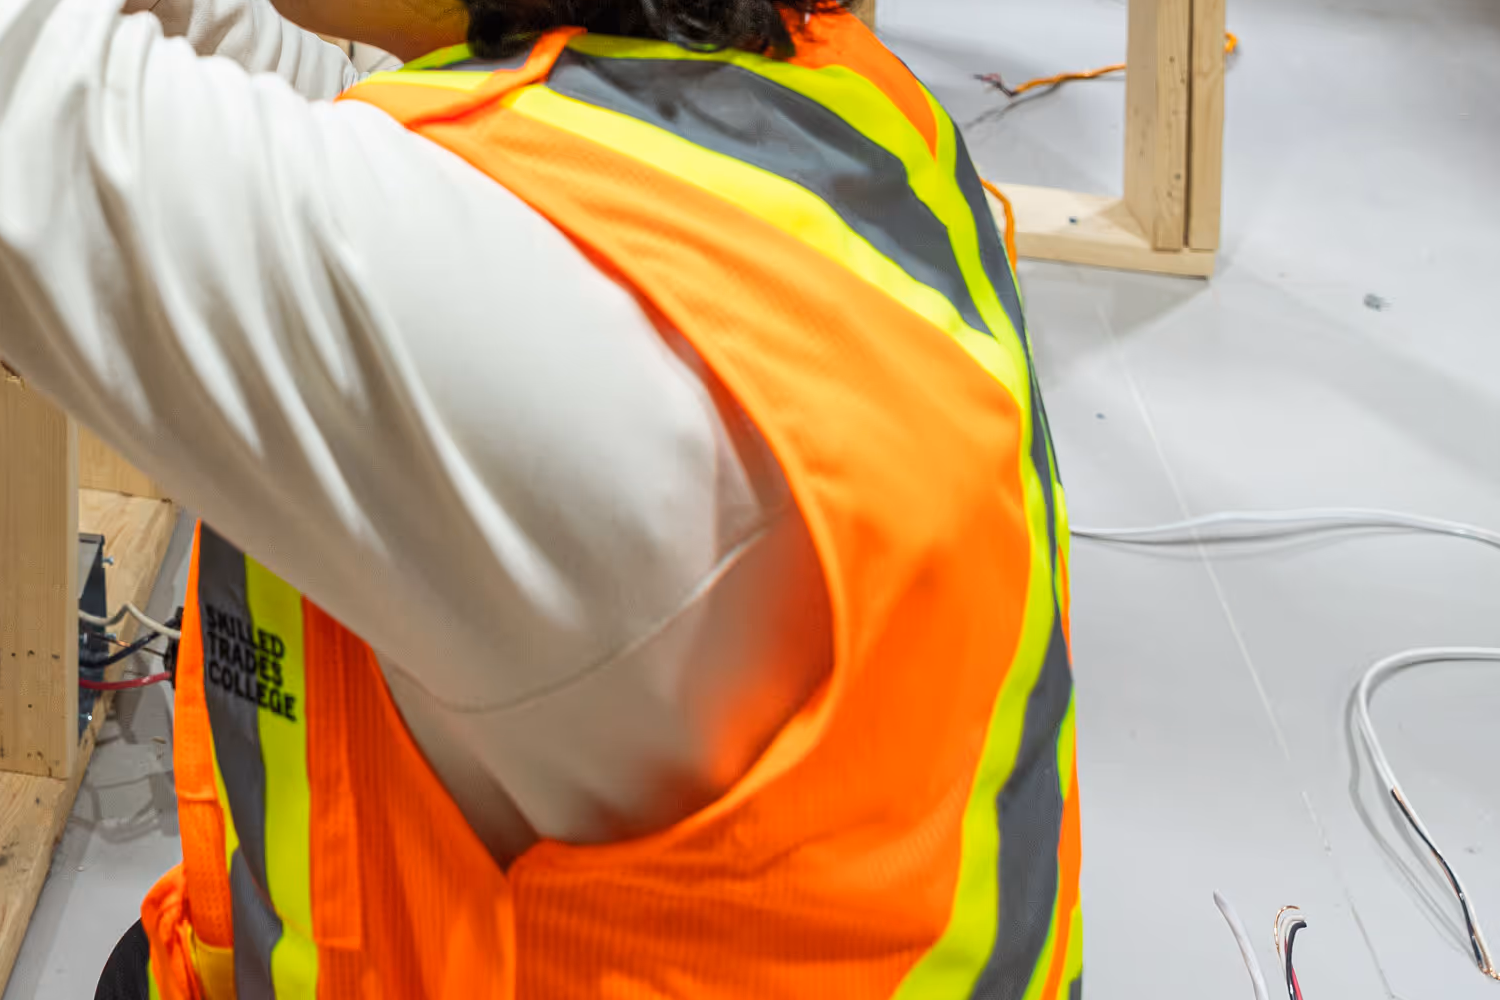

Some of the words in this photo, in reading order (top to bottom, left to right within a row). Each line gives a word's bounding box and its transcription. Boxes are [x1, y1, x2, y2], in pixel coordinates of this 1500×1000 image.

[205, 603, 285, 660] SKILLED
[206, 630, 284, 688] TRADES
[208, 660, 298, 722] COLLEGE
